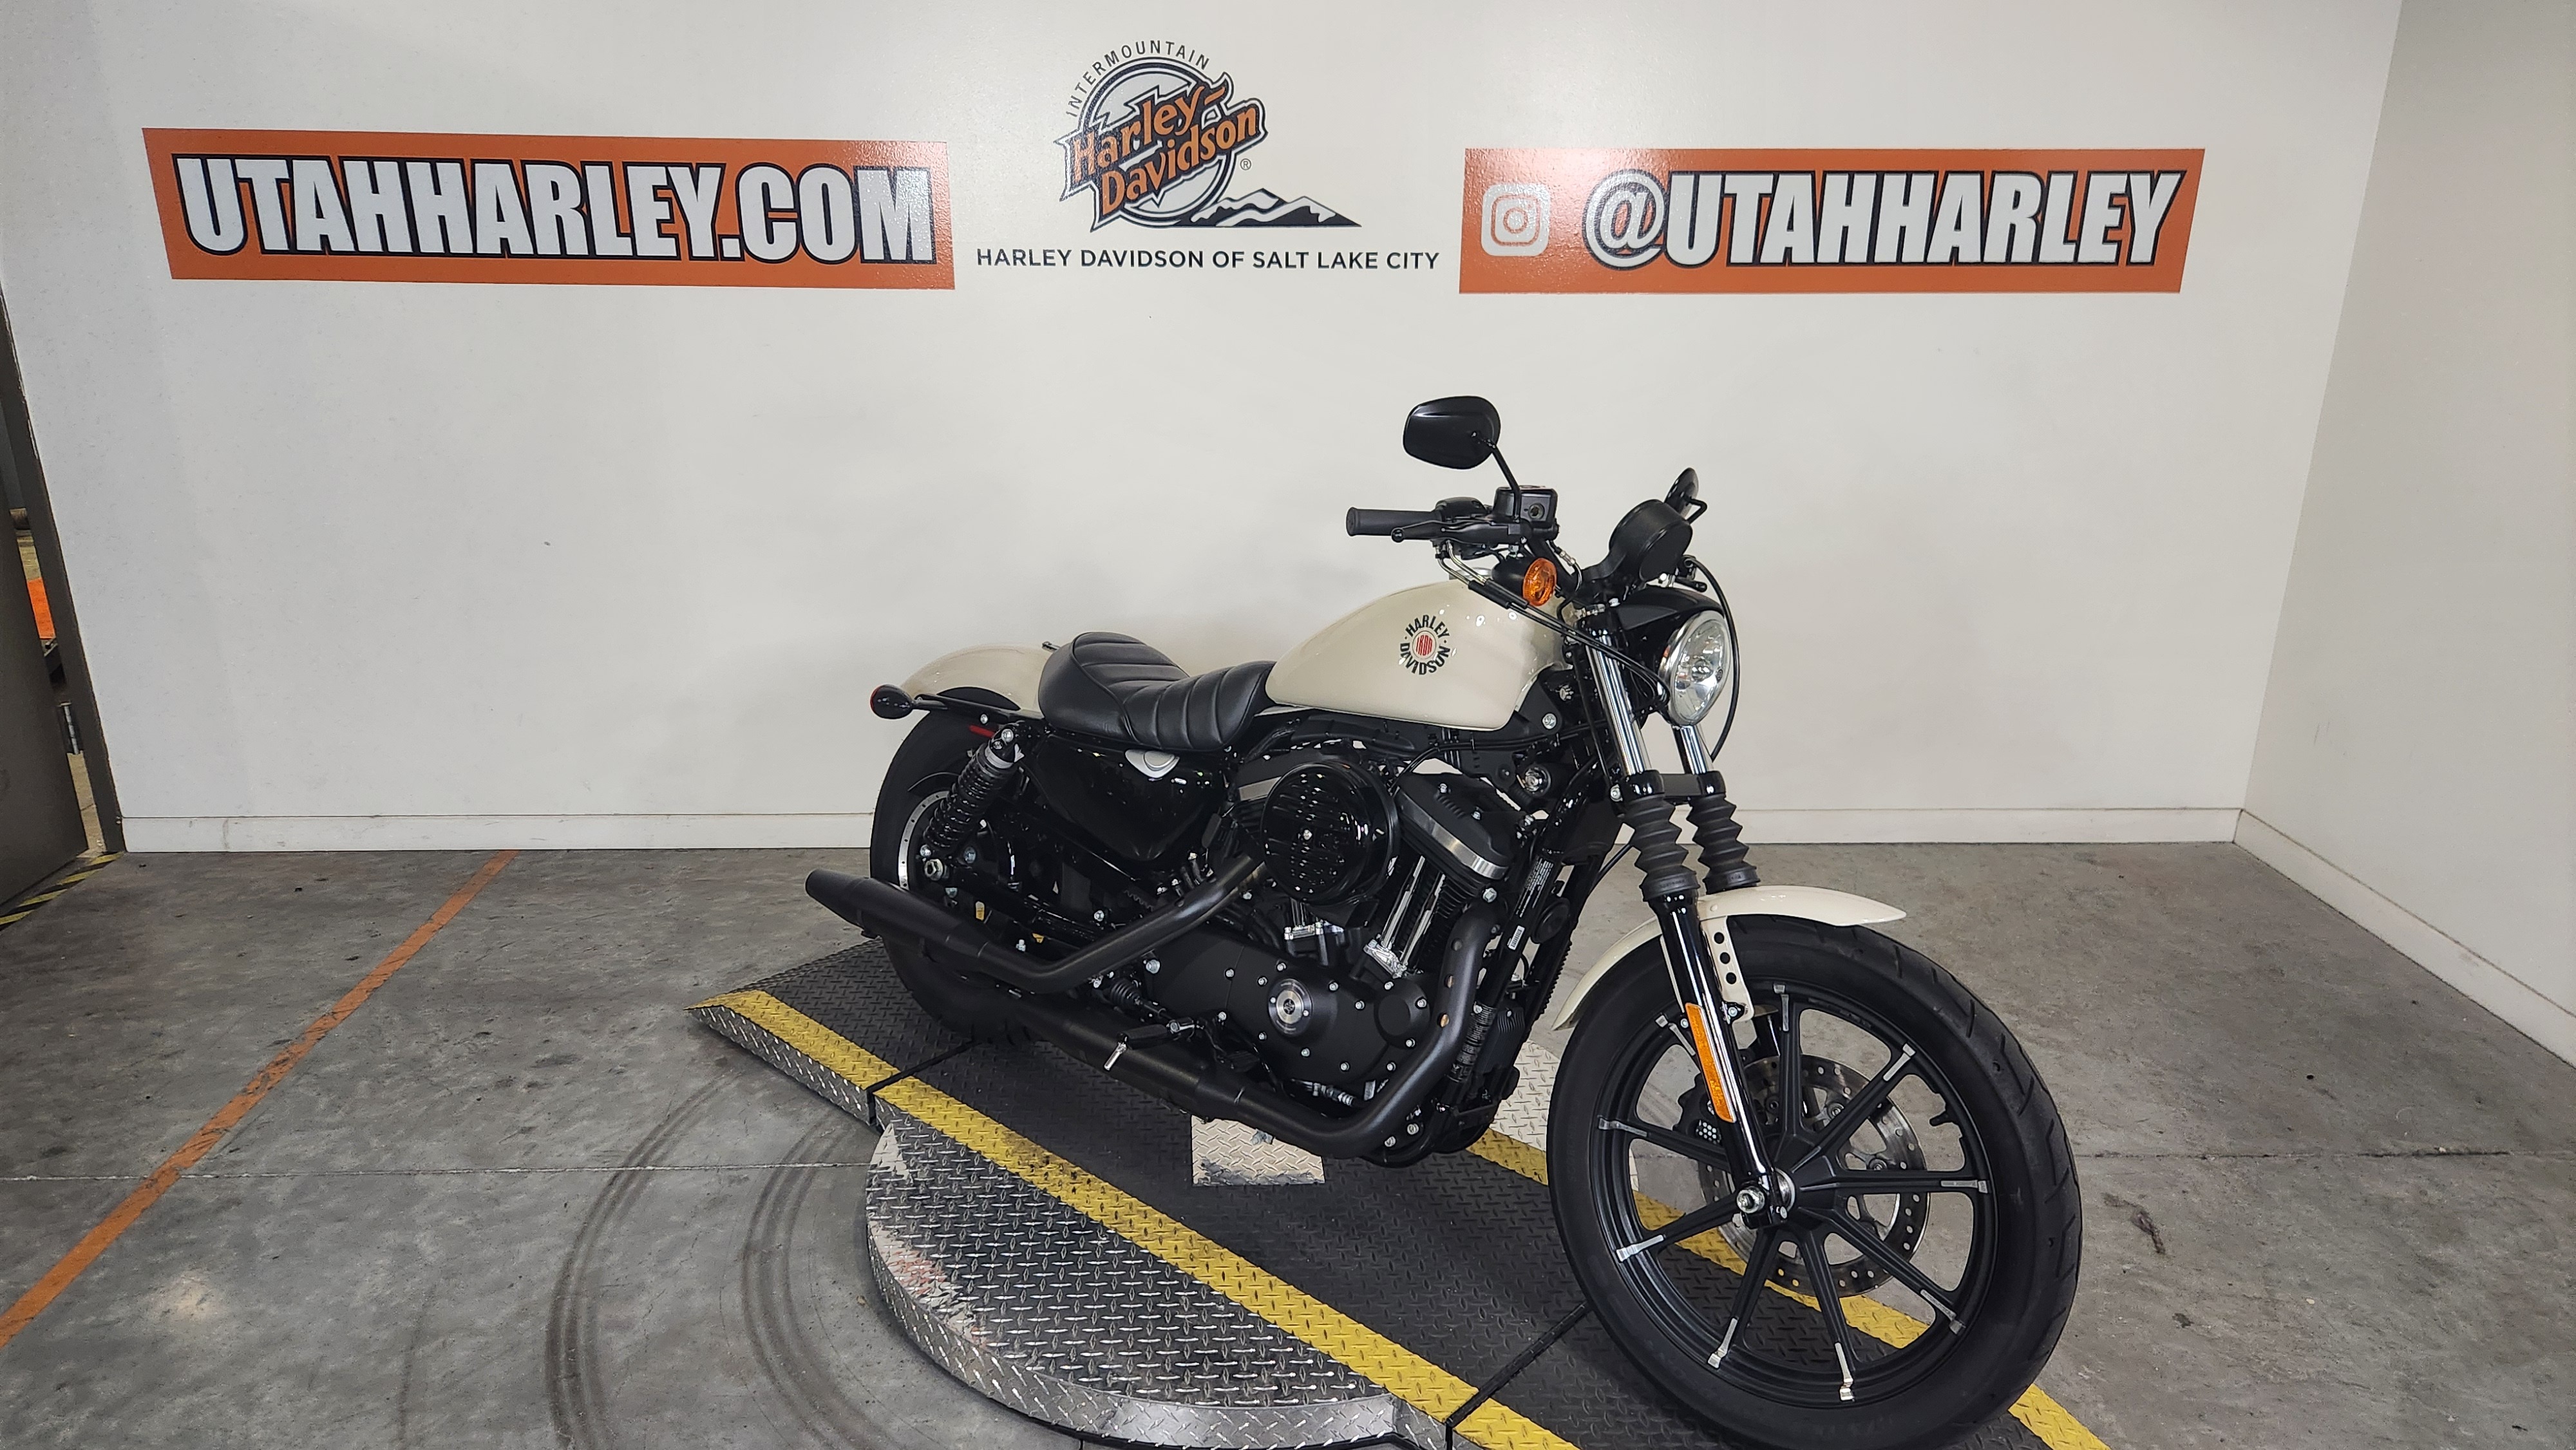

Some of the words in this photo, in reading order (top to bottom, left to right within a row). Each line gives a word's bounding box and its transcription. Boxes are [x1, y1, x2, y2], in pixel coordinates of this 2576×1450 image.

[1066, 40, 1209, 117] INTERMOUNTAIN
[1102, 108, 1256, 215] Davidson
[171, 153, 937, 265] UTAHHARLEY.COM
[1582, 169, 2187, 270] @UTAHHARLEY
[976, 248, 1072, 267] HARLEY
[1081, 249, 1204, 268] DAVIDSON
[1212, 250, 1245, 268] OF
[1253, 251, 1309, 269] SALT
[1318, 252, 1378, 270] LAKE
[1387, 252, 1440, 270] CITY
[1400, 643, 1451, 675] DAVIDSON
[1405, 614, 1450, 639] HARLEY
